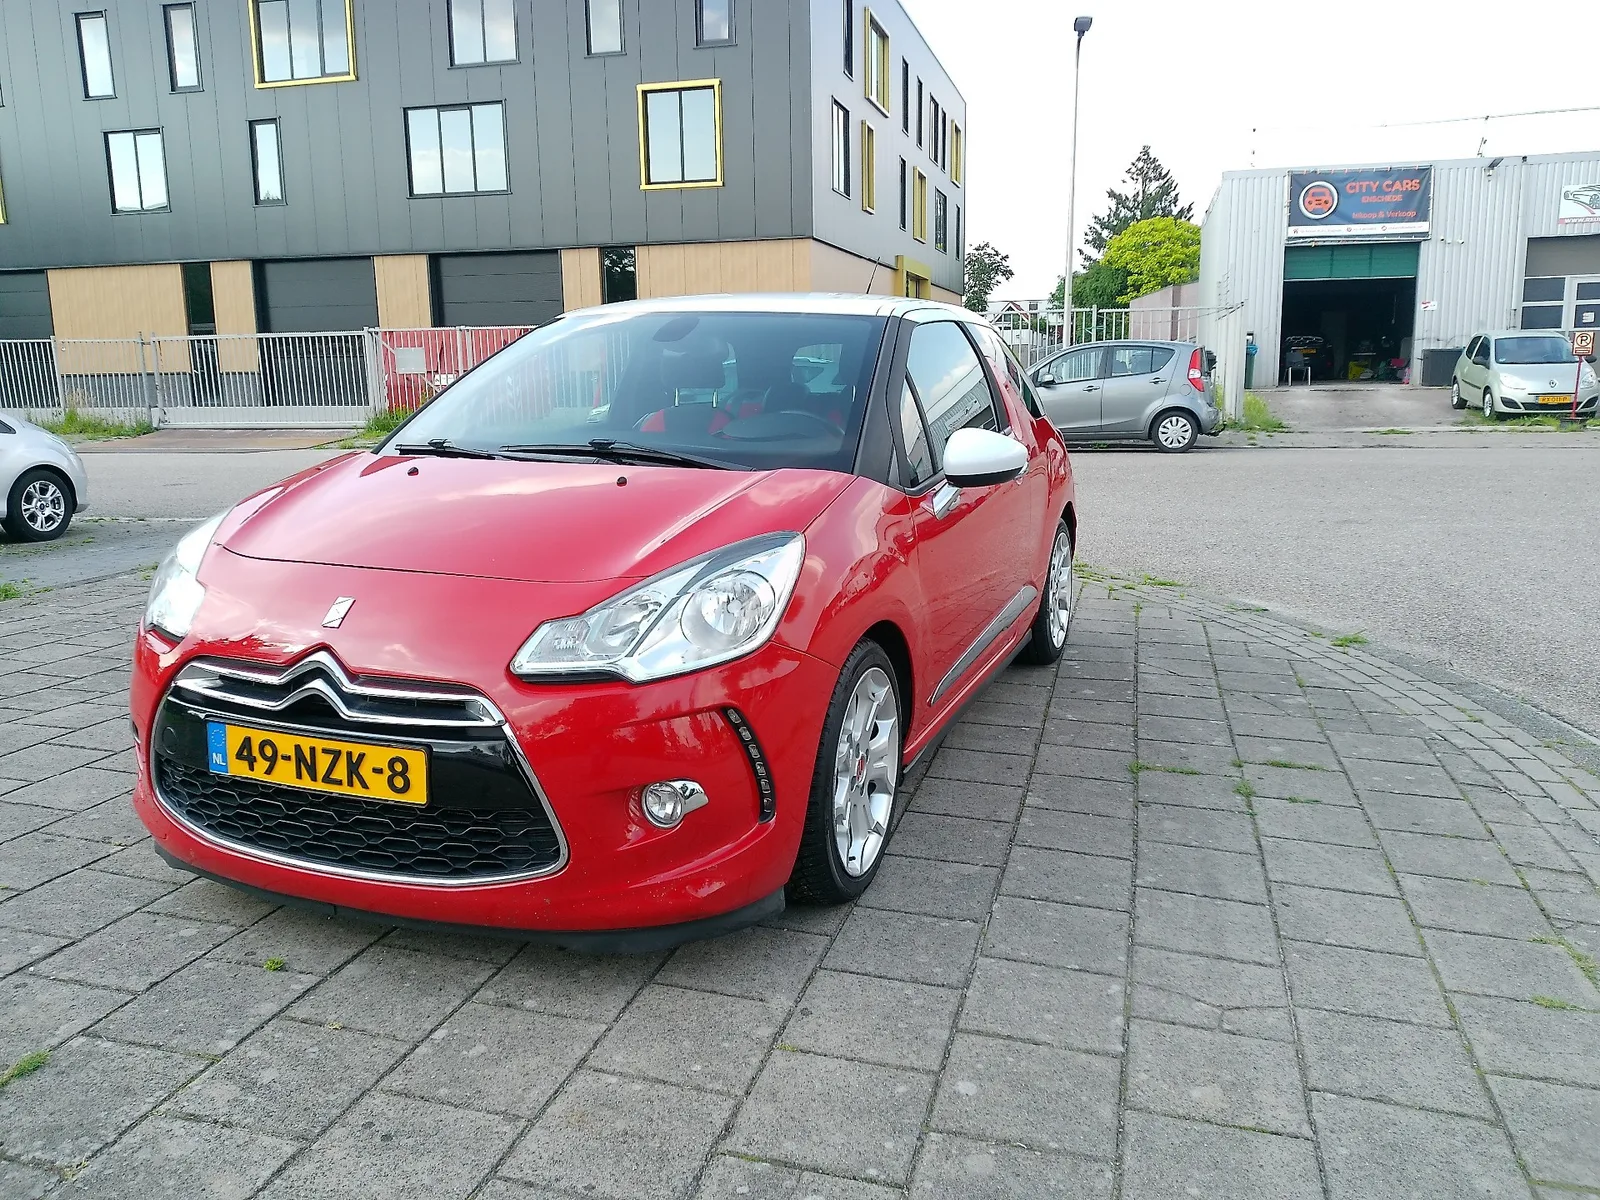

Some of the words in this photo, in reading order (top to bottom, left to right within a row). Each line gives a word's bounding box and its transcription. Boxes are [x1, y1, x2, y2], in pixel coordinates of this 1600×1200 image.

[1345, 181, 1380, 194] CITY
[1382, 179, 1420, 192] CARS
[1387, 209, 1417, 218] Verkoop
[212, 752, 227, 766] NL
[235, 736, 411, 795] 49-NZK-8
